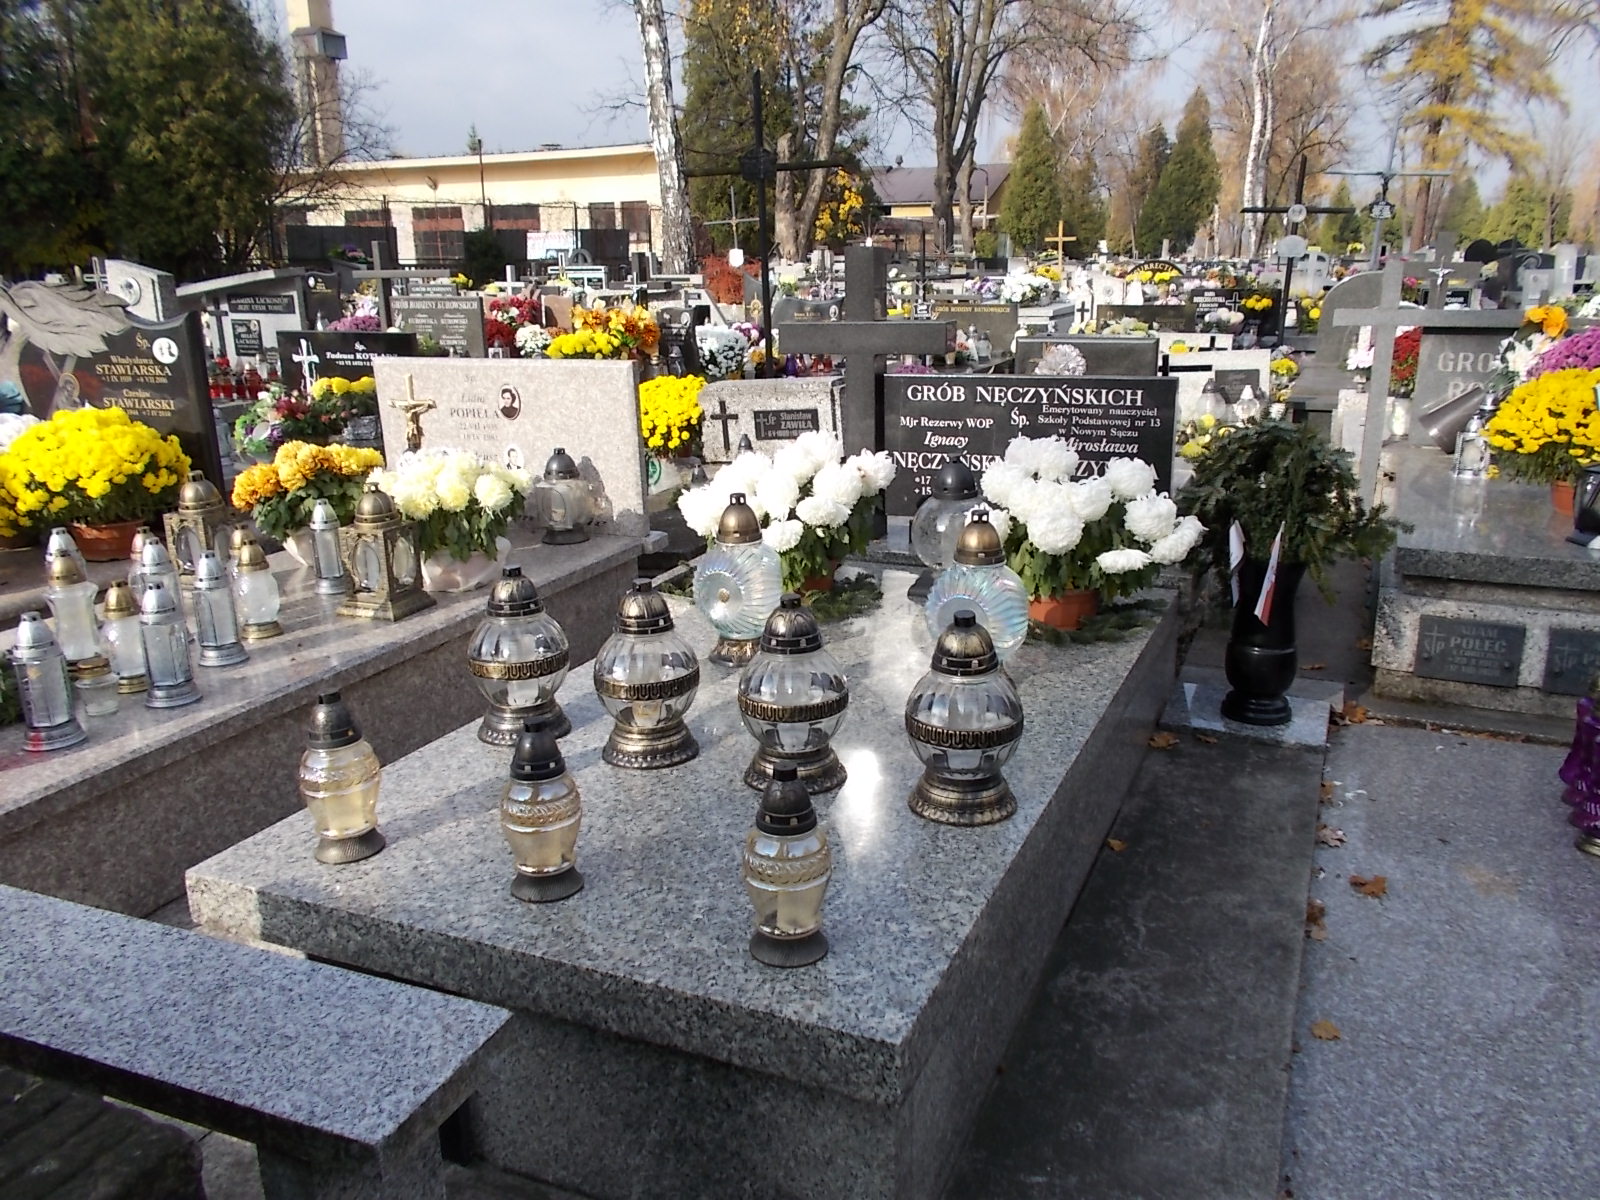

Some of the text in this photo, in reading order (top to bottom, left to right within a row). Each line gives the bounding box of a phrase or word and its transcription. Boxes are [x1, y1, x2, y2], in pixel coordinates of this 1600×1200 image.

[1438, 351, 1495, 373] GRO
[95, 364, 172, 376] STAWIARSKA
[907, 382, 1144, 407] GRÓB NĘCZYŃSKICH
[102, 397, 176, 410] STAWIARSKI
[1042, 404, 1158, 418] Emerytowany nauczyciel
[900, 415, 994, 430] Mjr Rezerwy WOP
[1010, 407, 1030, 428] Śp.
[1038, 414, 1161, 428] Szkoły Podstawowej nr 13
[923, 431, 969, 449] Ignacy
[1071, 427, 1107, 437] Nowym
[1110, 428, 1139, 439] Sączu
[892, 450, 1005, 472] NĘCZŃSK
